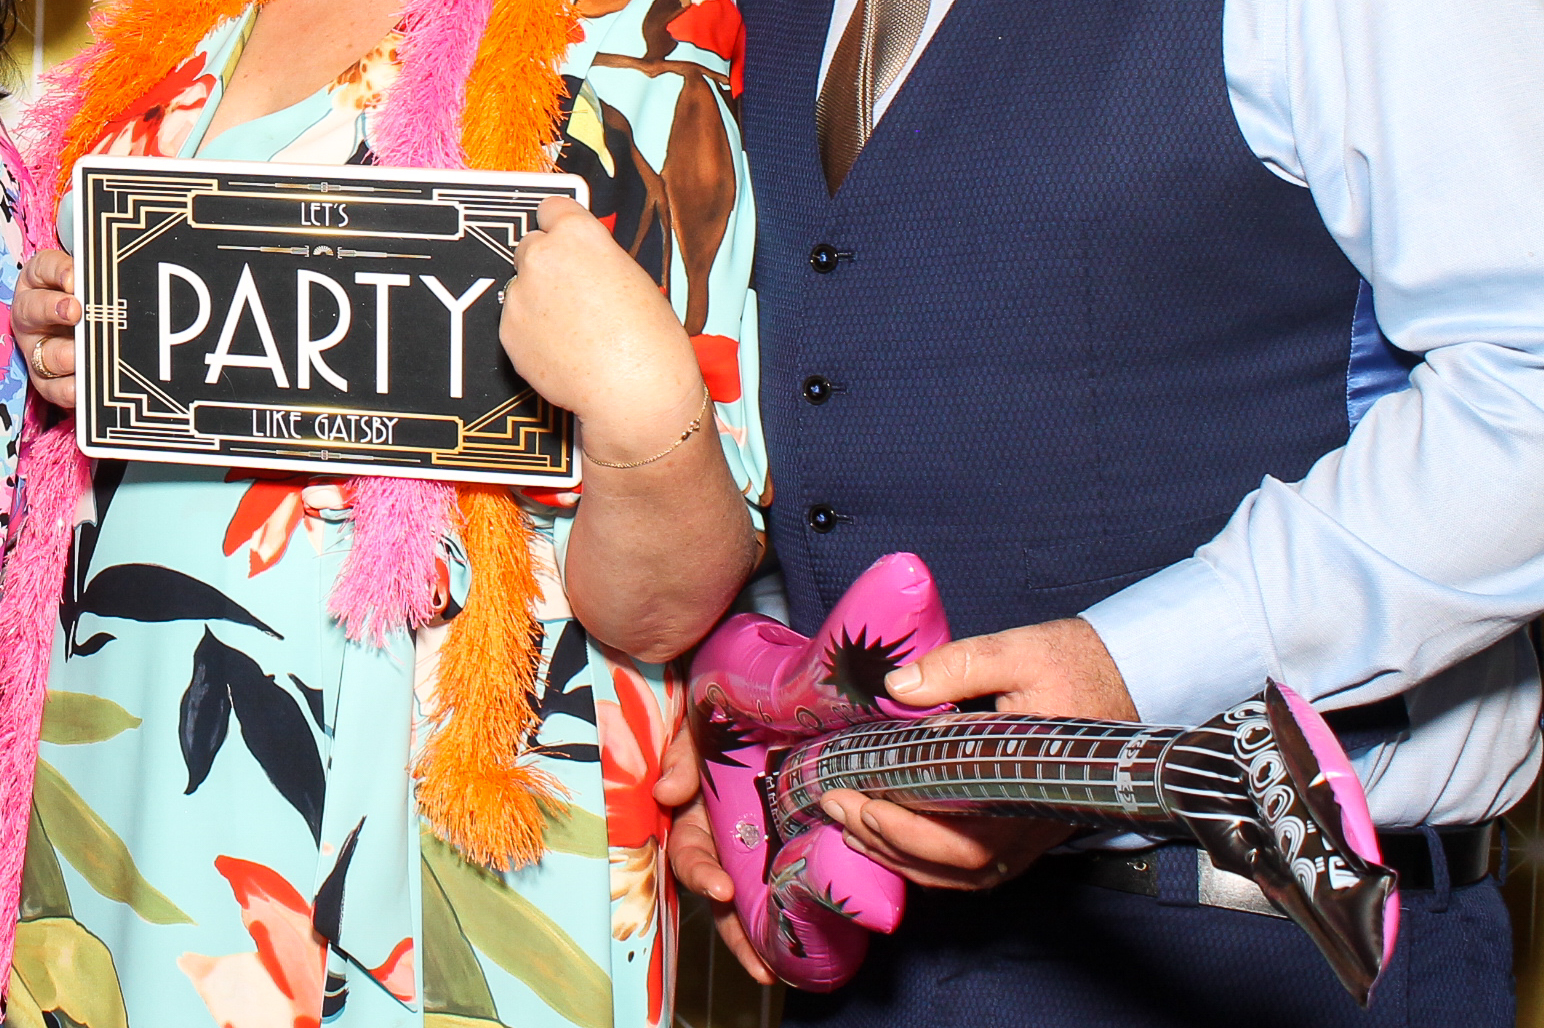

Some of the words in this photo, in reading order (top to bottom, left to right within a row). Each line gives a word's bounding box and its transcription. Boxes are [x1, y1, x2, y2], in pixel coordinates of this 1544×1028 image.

[300, 201, 350, 228] LET'S
[157, 261, 497, 399] PARTY
[252, 409, 302, 440] LIKE
[314, 413, 400, 446] GATSBY
